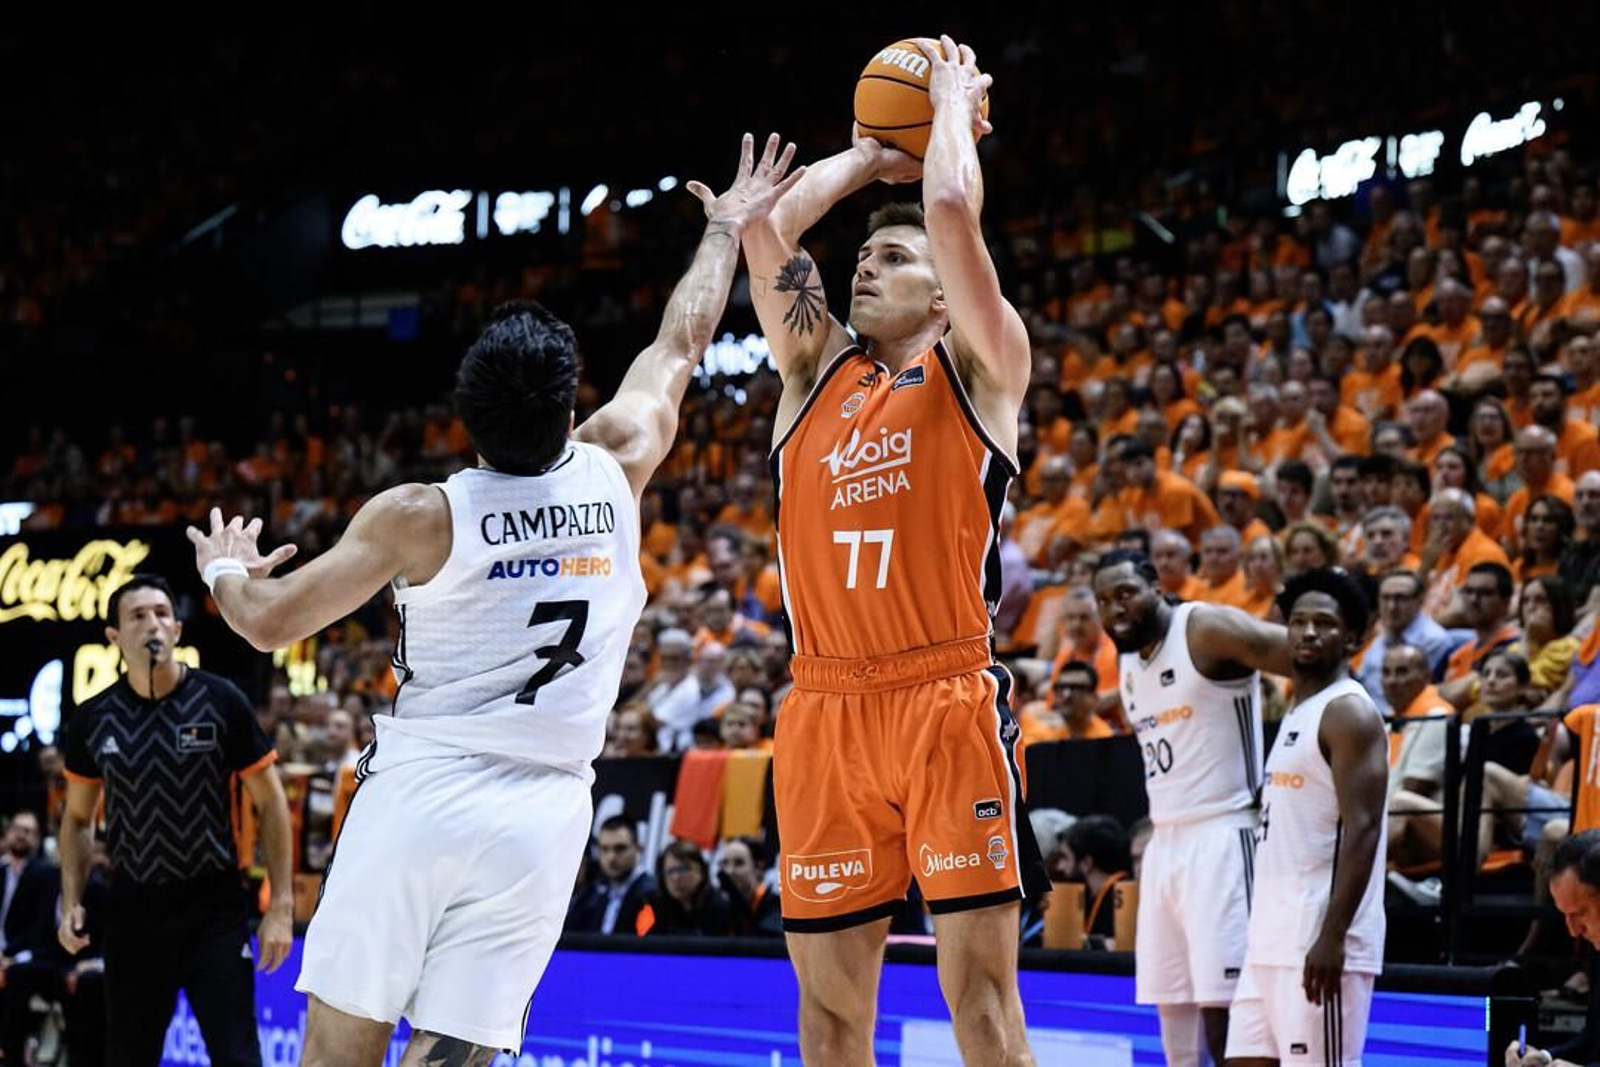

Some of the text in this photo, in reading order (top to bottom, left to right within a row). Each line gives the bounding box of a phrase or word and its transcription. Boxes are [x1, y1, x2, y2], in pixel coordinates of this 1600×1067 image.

[820, 427, 912, 484] Roig
[831, 470, 911, 510] ARENA
[480, 501, 616, 546] CAMPAZZO
[486, 556, 612, 580] AUTOHERO
[832, 529, 895, 589] 77
[514, 599, 590, 705] 7
[977, 807, 998, 817] acb
[790, 859, 866, 881] PULEVA
[920, 845, 981, 878] Midea
